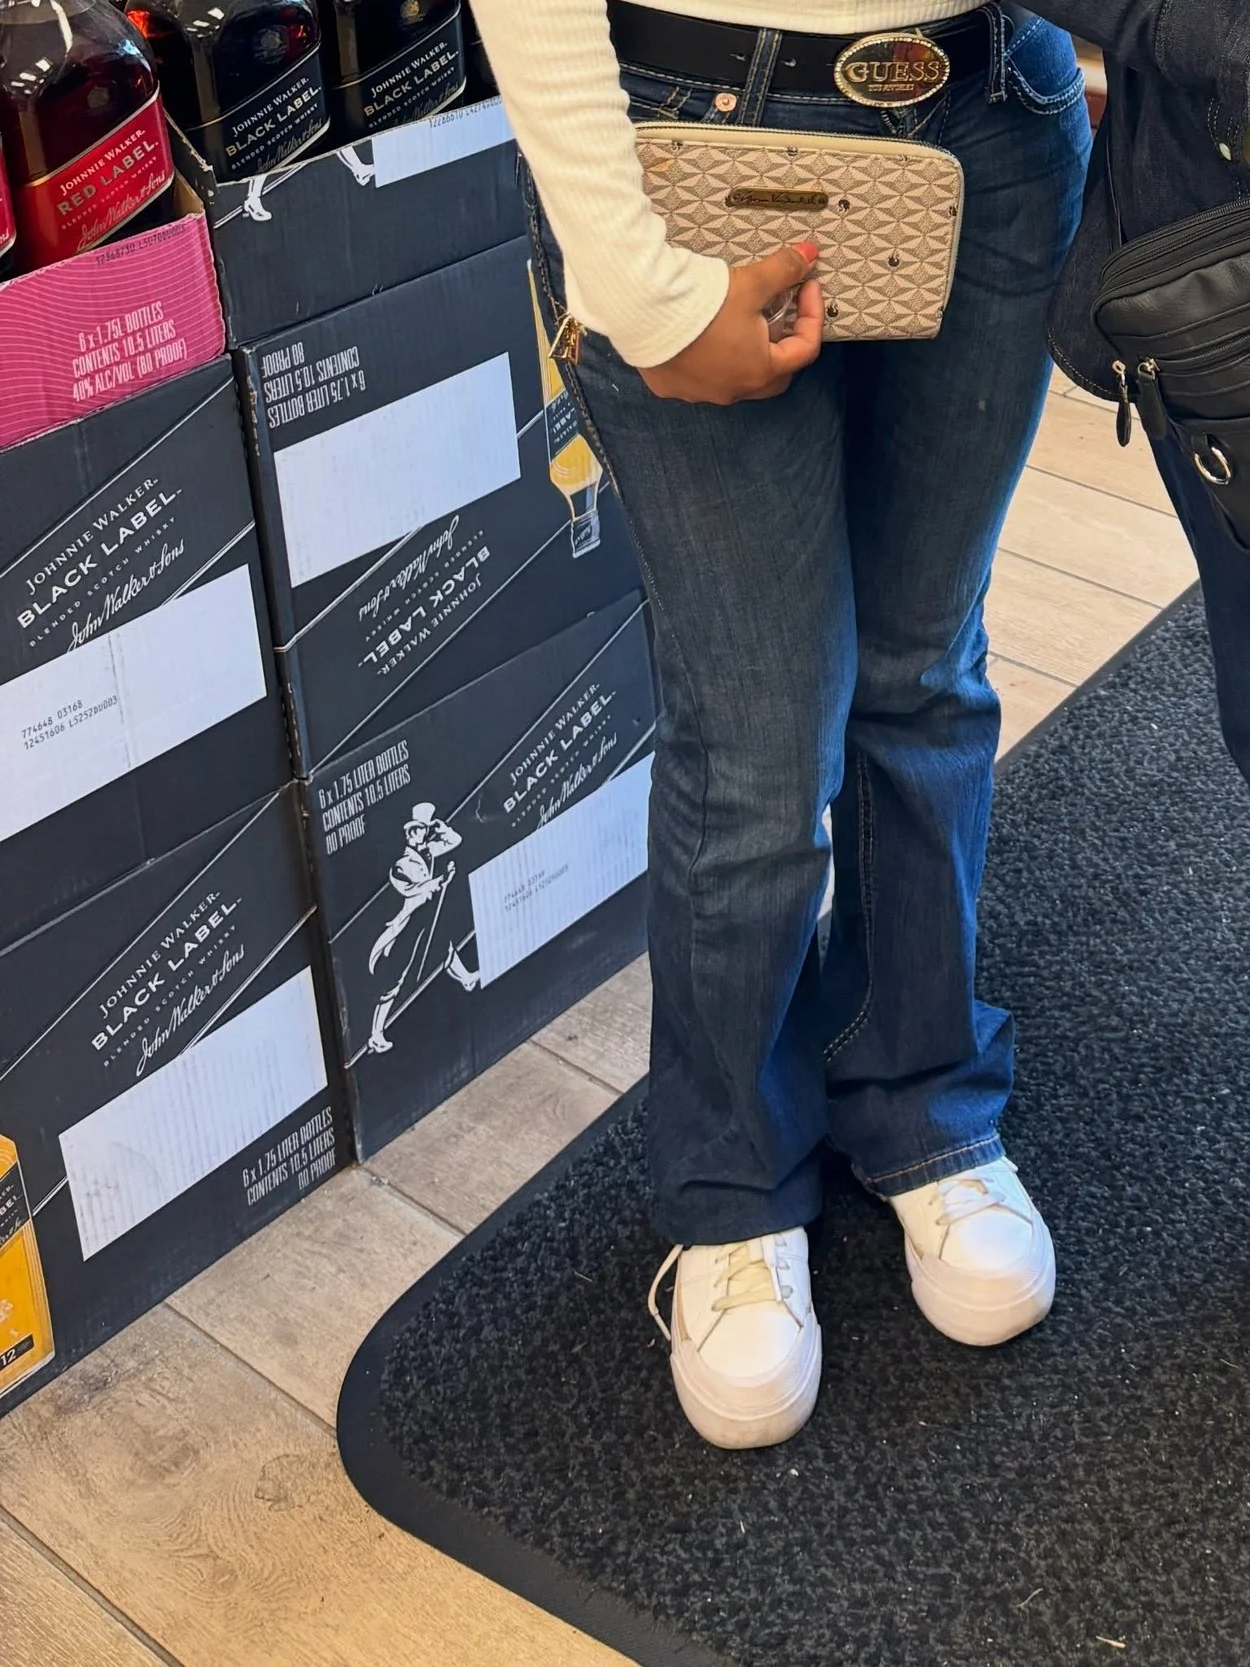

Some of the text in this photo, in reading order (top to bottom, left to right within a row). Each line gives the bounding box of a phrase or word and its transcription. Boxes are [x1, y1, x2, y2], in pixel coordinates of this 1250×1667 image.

[843, 61, 940, 83] GUESS
[363, 82, 413, 118] BLACK
[57, 182, 97, 216] RED
[124, 300, 164, 331] BOTTLES
[71, 376, 95, 403] 40%
[94, 357, 136, 395] ALC/VOL
[154, 336, 189, 371] PROOF)
[72, 340, 121, 379] CONTENTS
[144, 319, 177, 351] LITERS
[261, 348, 291, 379] PROOF
[317, 345, 360, 383] CONTENTS
[263, 372, 295, 404] LITERS
[267, 394, 307, 429] BOTTLES
[306, 387, 330, 413] LITER
[25, 530, 94, 595] JOHNNIE
[428, 545, 491, 608] BLACK
[16, 554, 98, 630] BLACK
[430, 572, 482, 628] JOHNNIE
[318, 788, 327, 810] 6
[333, 772, 353, 801] 1.75
[352, 759, 376, 789] LITER
[375, 739, 410, 776] BOTTLES
[502, 749, 559, 814] BLACK
[510, 731, 556, 786] JOHNNIE
[322, 763, 411, 832] CONTENTS 10.5 LITERS
[338, 813, 366, 849] PROOF
[91, 971, 166, 1052] BLACK
[99, 949, 162, 1019] JOHNNIE
[246, 1126, 336, 1206] CONTENTS 10.5 LITERS
[310, 1147, 336, 1182] PROOF
